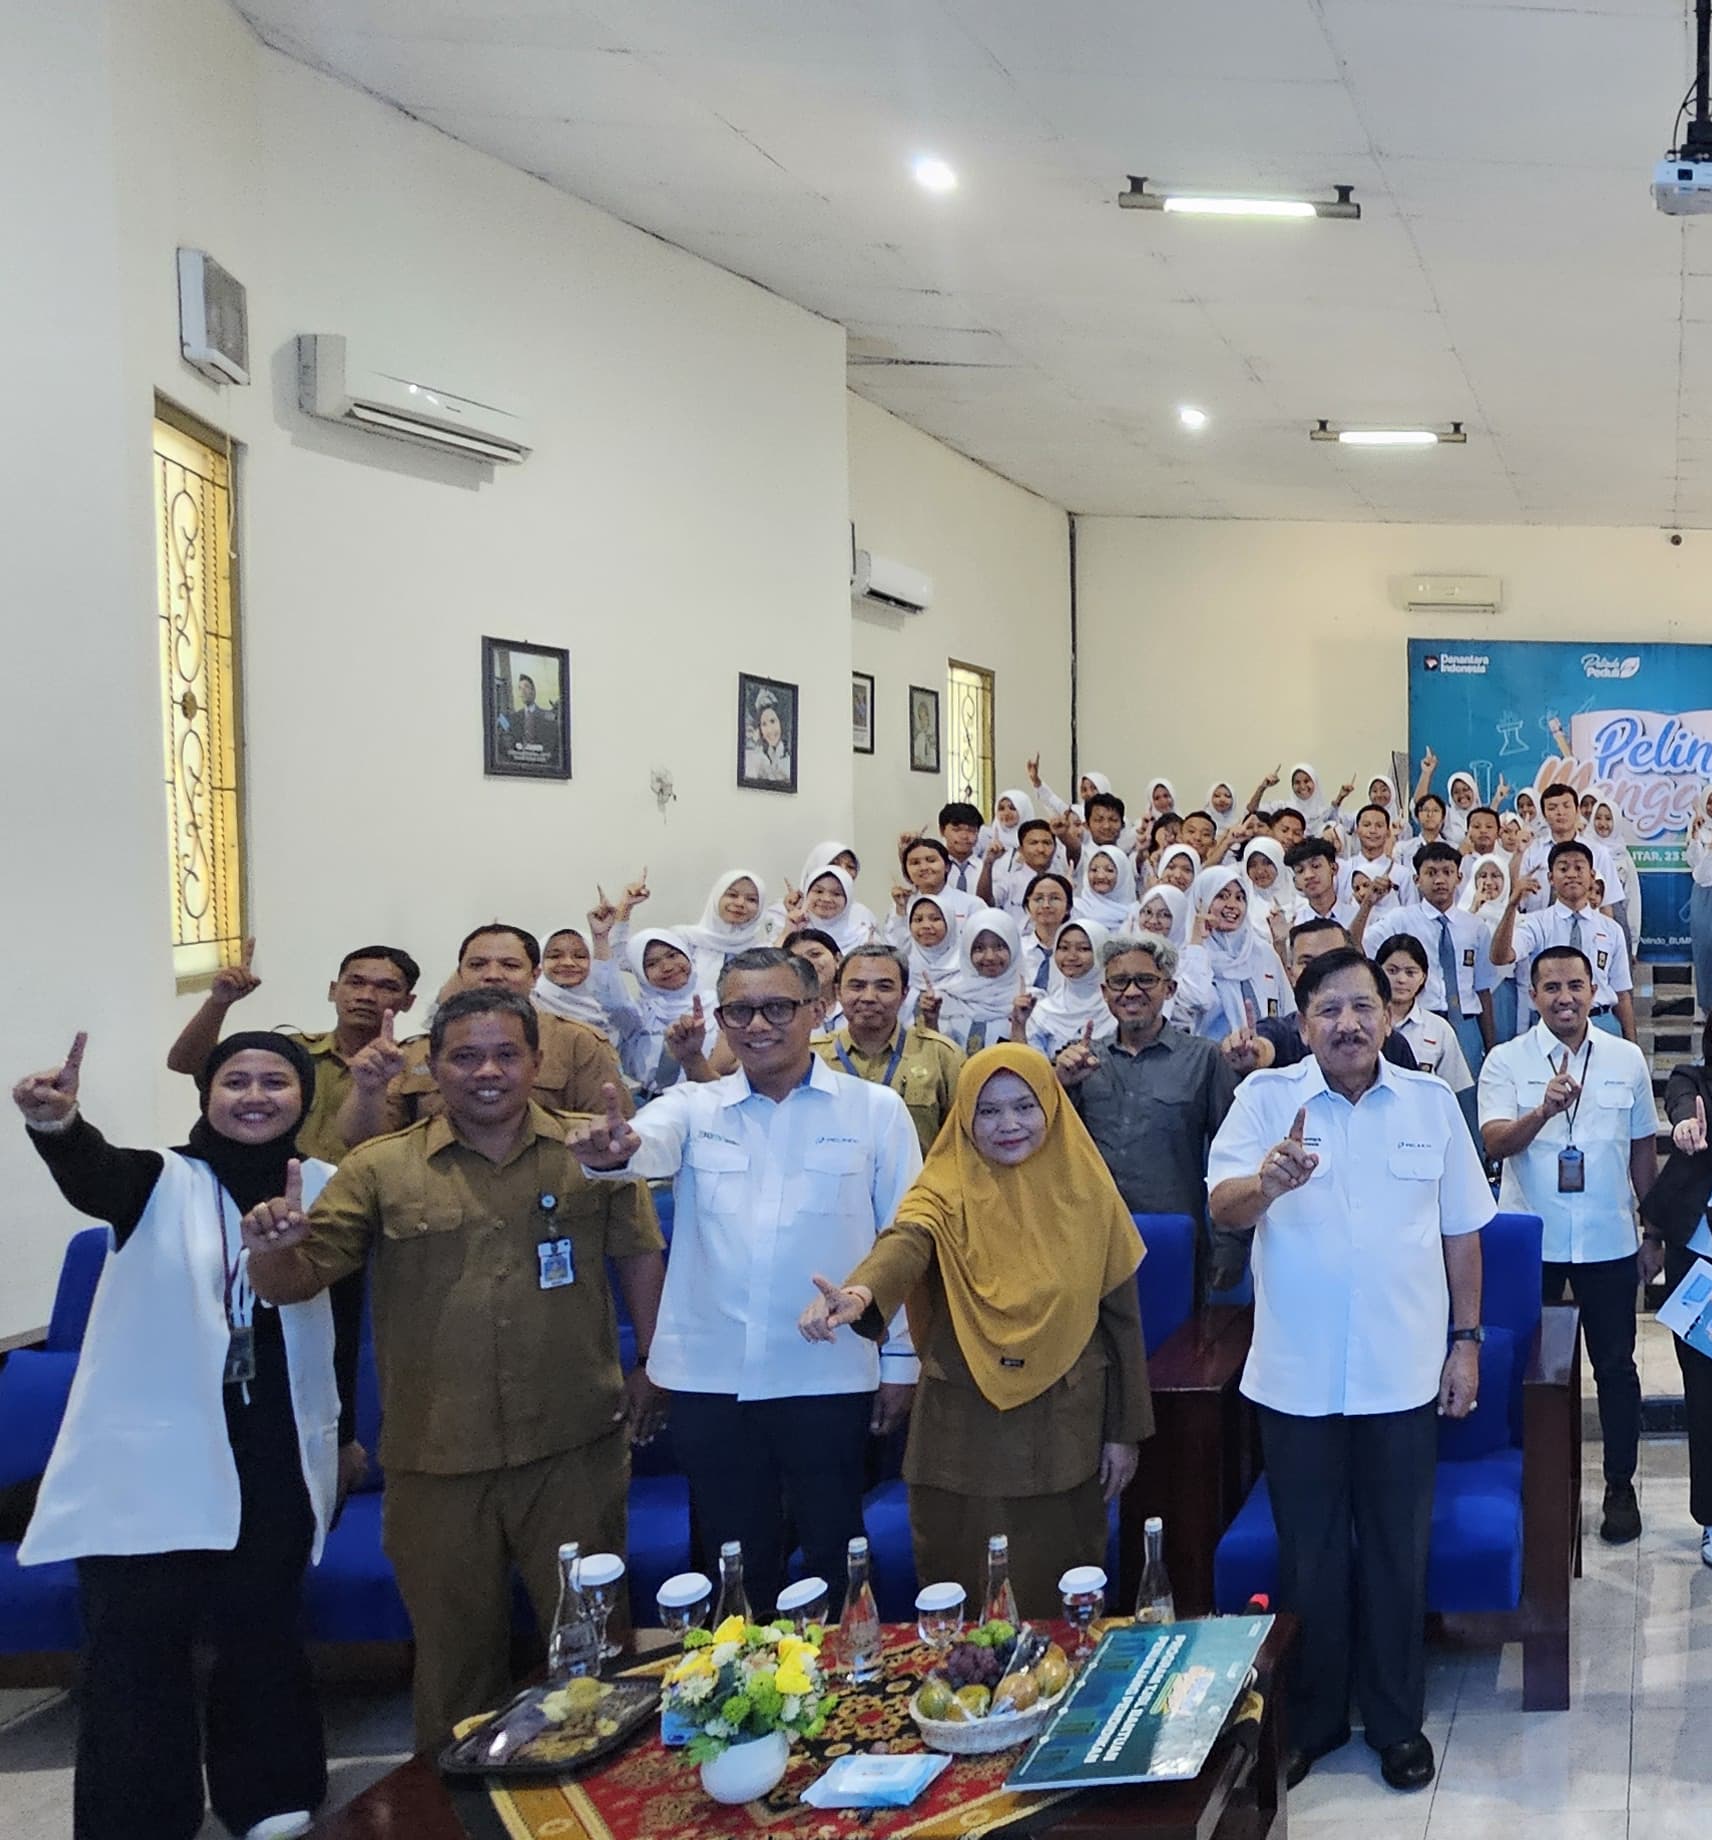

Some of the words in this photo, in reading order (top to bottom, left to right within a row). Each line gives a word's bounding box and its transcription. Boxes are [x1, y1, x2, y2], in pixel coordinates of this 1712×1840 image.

[1440, 653, 1489, 665] Danantara
[1440, 664, 1486, 673] Indonesia
[1150, 1634, 1187, 1684] PROGRAM
[1083, 1695, 1135, 1764] PENDIDIKAN
[1103, 1707, 1145, 1762] BANTUAN
